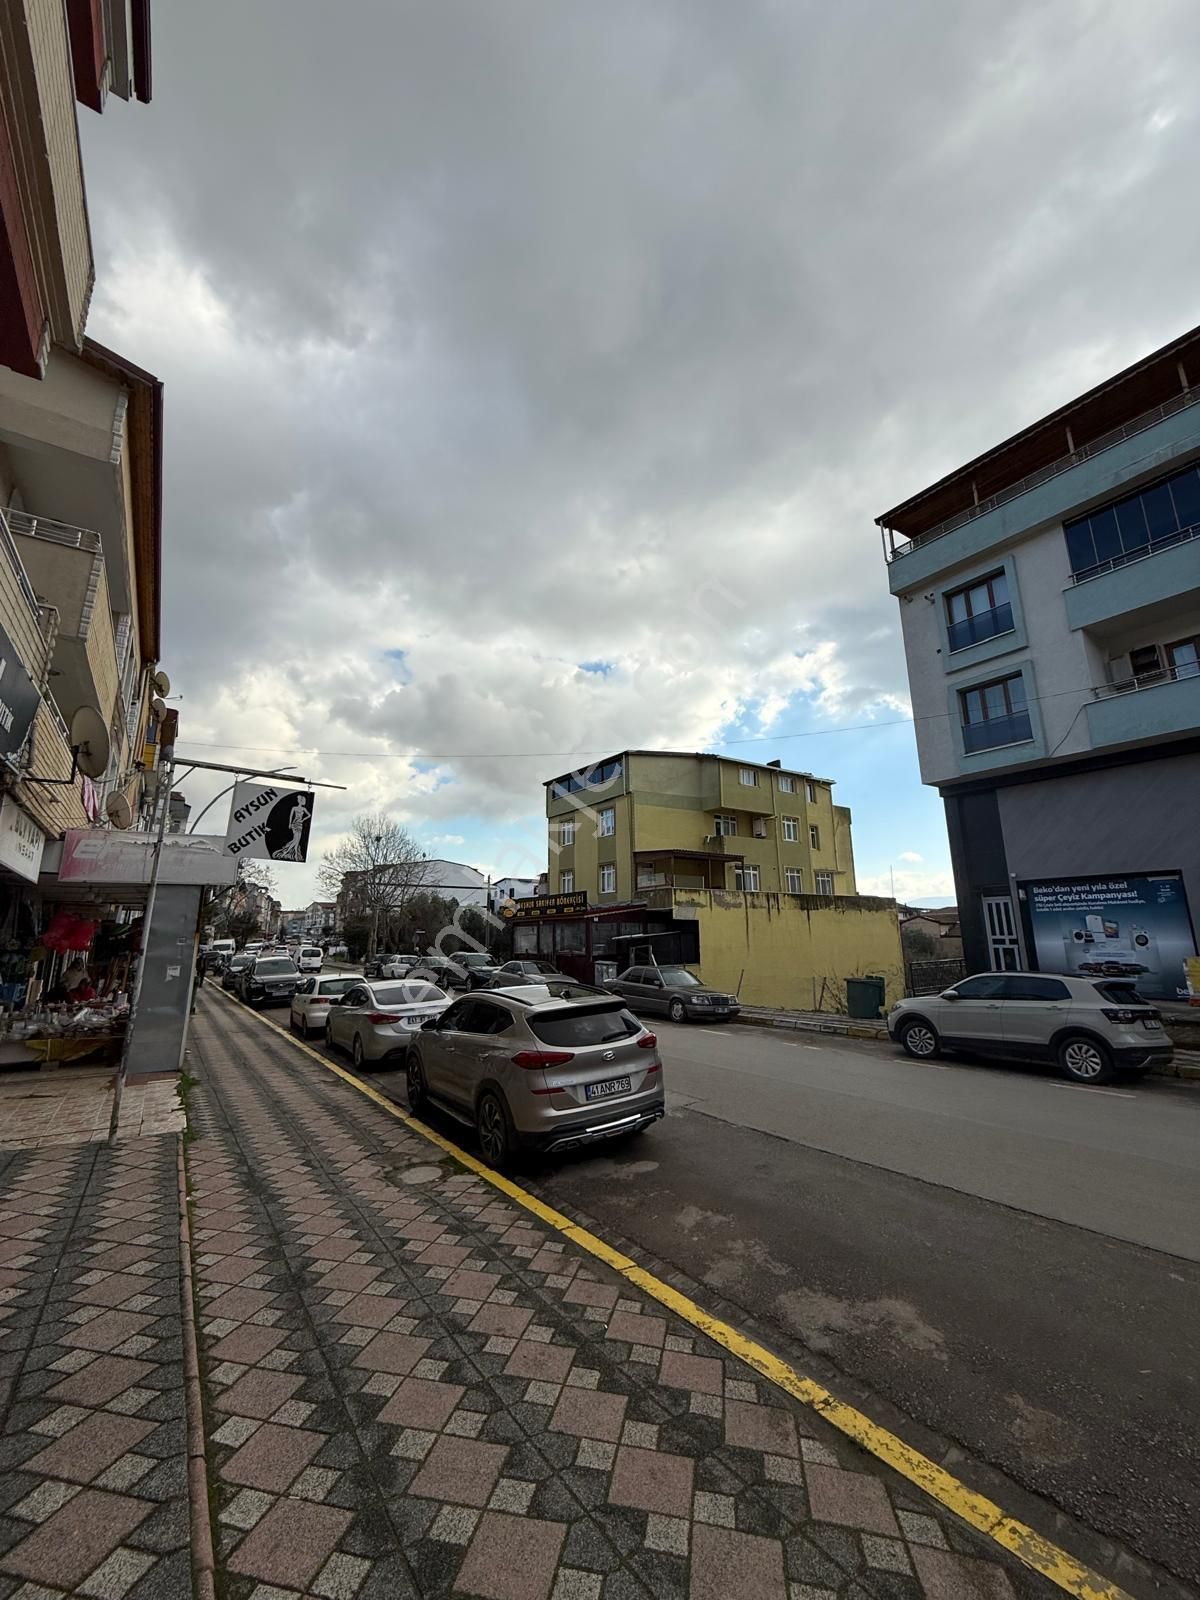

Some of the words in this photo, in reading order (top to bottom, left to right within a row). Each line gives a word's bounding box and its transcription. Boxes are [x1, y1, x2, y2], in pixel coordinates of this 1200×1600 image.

[234, 788, 278, 823] AYSUN
[227, 822, 271, 854] BUTİK
[1033, 885, 1070, 894] Beko'dan
[1071, 883, 1089, 893] yeni
[1091, 881, 1108, 892] yıla
[1109, 880, 1128, 890] özel
[1034, 893, 1056, 903] süper
[1057, 892, 1080, 903] Çeyiz
[1081, 889, 1138, 901] Kampanyası!
[591, 1086, 599, 1096] 41
[600, 1082, 616, 1094] ANR
[616, 1079, 629, 1091] 769
